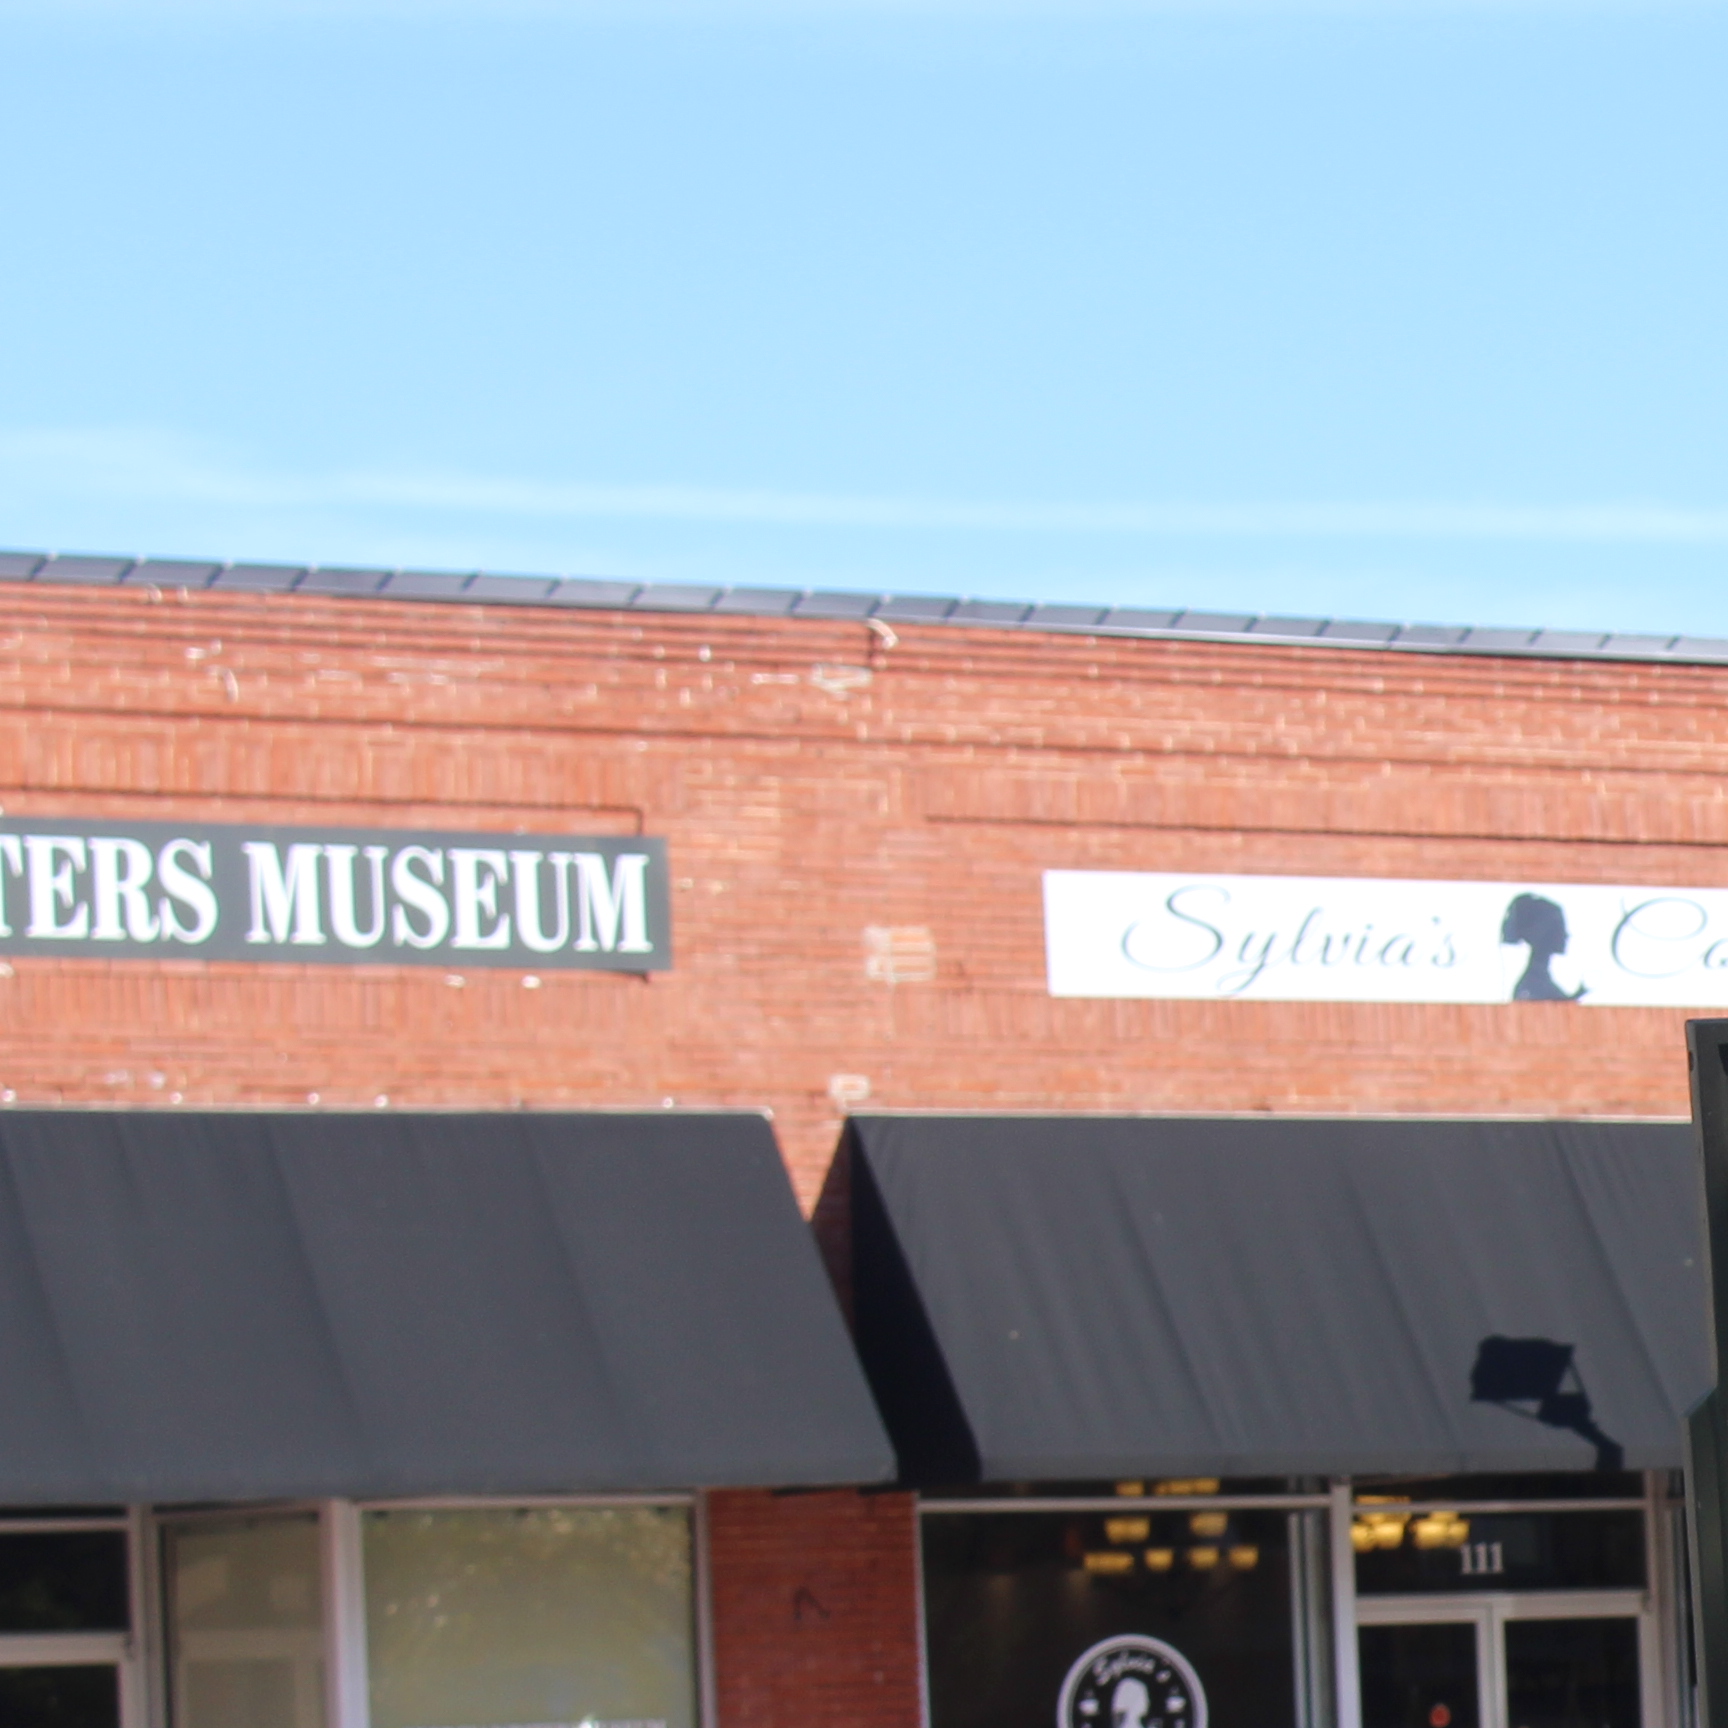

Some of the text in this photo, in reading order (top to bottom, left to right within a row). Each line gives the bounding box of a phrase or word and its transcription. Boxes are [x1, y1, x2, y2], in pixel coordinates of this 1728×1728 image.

[243, 839, 653, 954] MUSEUM
[1121, 884, 1465, 997] Sylvia's
[1461, 1542, 1503, 1575] 111
